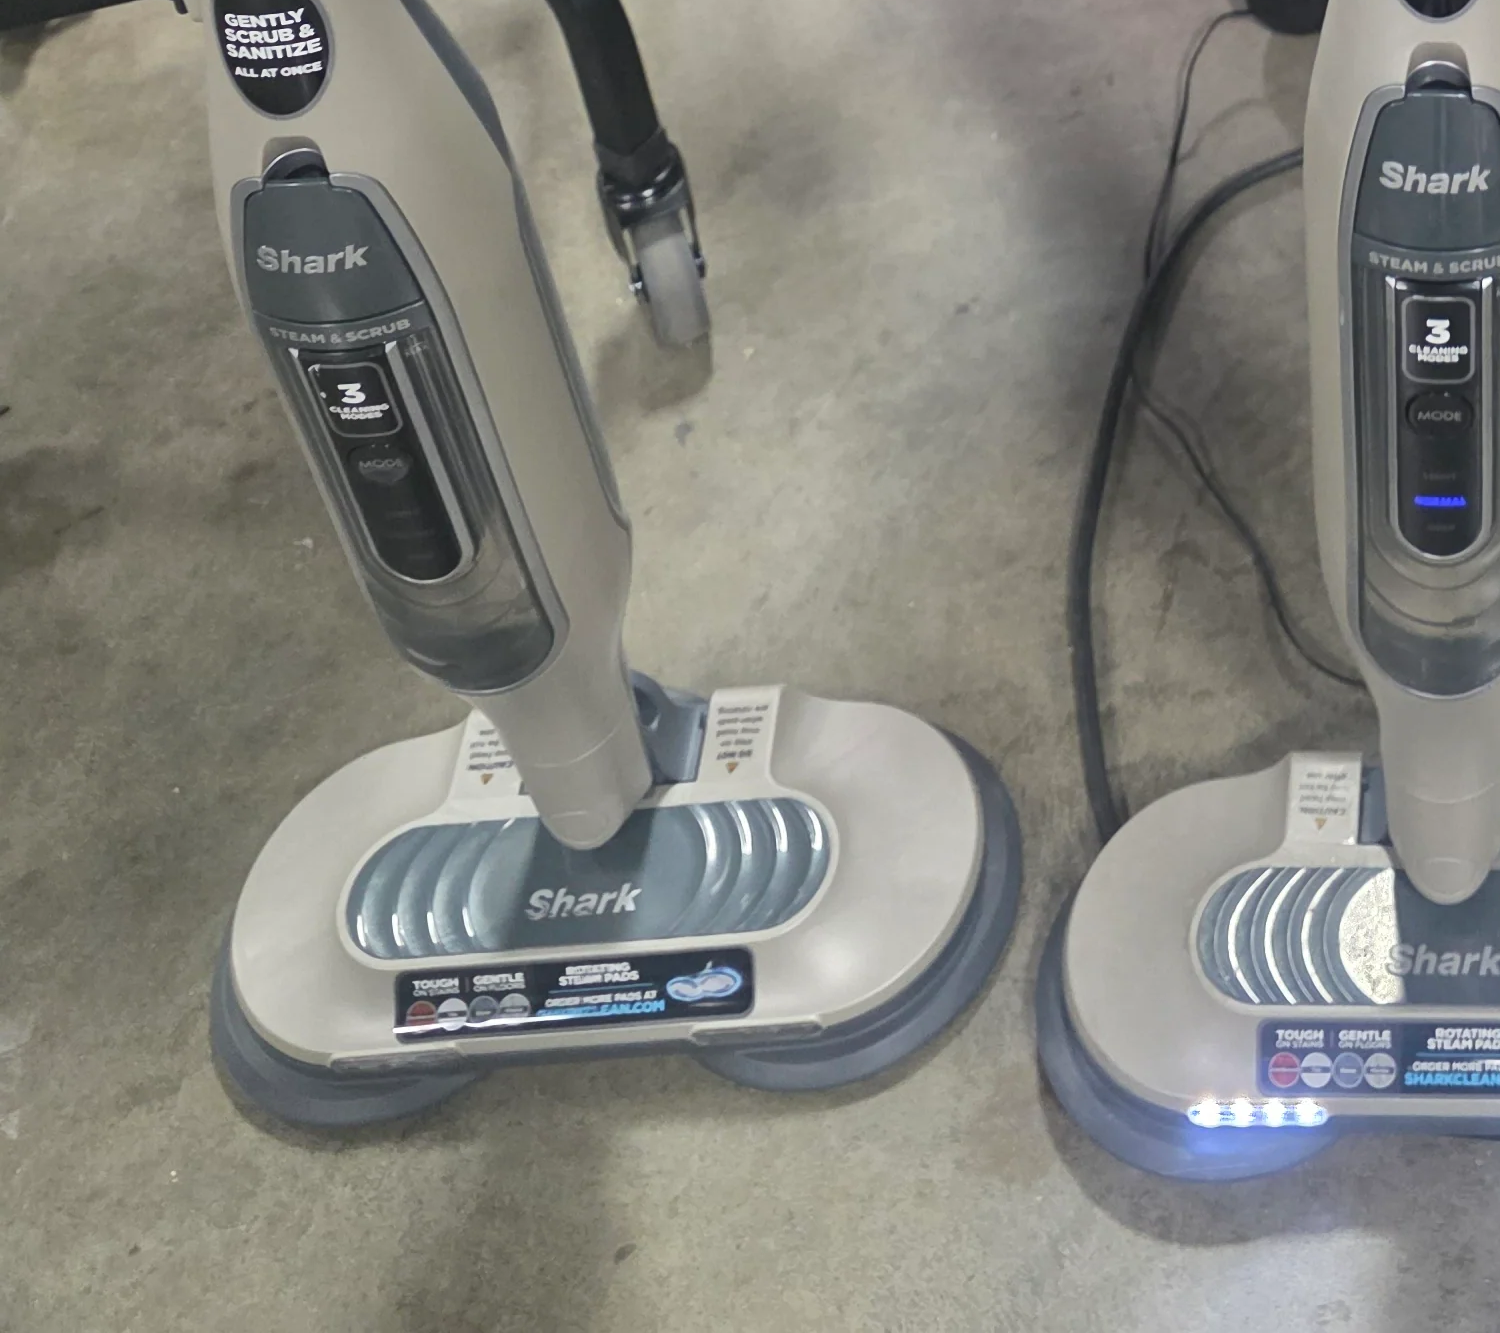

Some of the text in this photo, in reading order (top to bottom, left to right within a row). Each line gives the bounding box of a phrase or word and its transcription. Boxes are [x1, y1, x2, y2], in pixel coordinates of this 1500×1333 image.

[224, 7, 305, 28] GENTLY
[225, 23, 315, 44] SCRUB &
[226, 38, 323, 60] SANITIZE
[235, 61, 323, 78] ALL AT ONCE
[1379, 161, 1491, 195] Shark
[256, 243, 370, 275] Shark
[1368, 250, 1428, 274] STEAM
[1433, 262, 1444, 274] &
[269, 318, 411, 344] STEAM & SCRUB
[1425, 318, 1451, 344] 3
[337, 383, 366, 404] 3
[1417, 410, 1462, 422] MODE
[526, 882, 642, 920] Shark
[412, 972, 525, 990] TOUGH GENTLE
[604, 970, 640, 983] PADS
[1275, 1029, 1391, 1040] TOUGH GENTLE
[1427, 1038, 1473, 1050] STEAM
